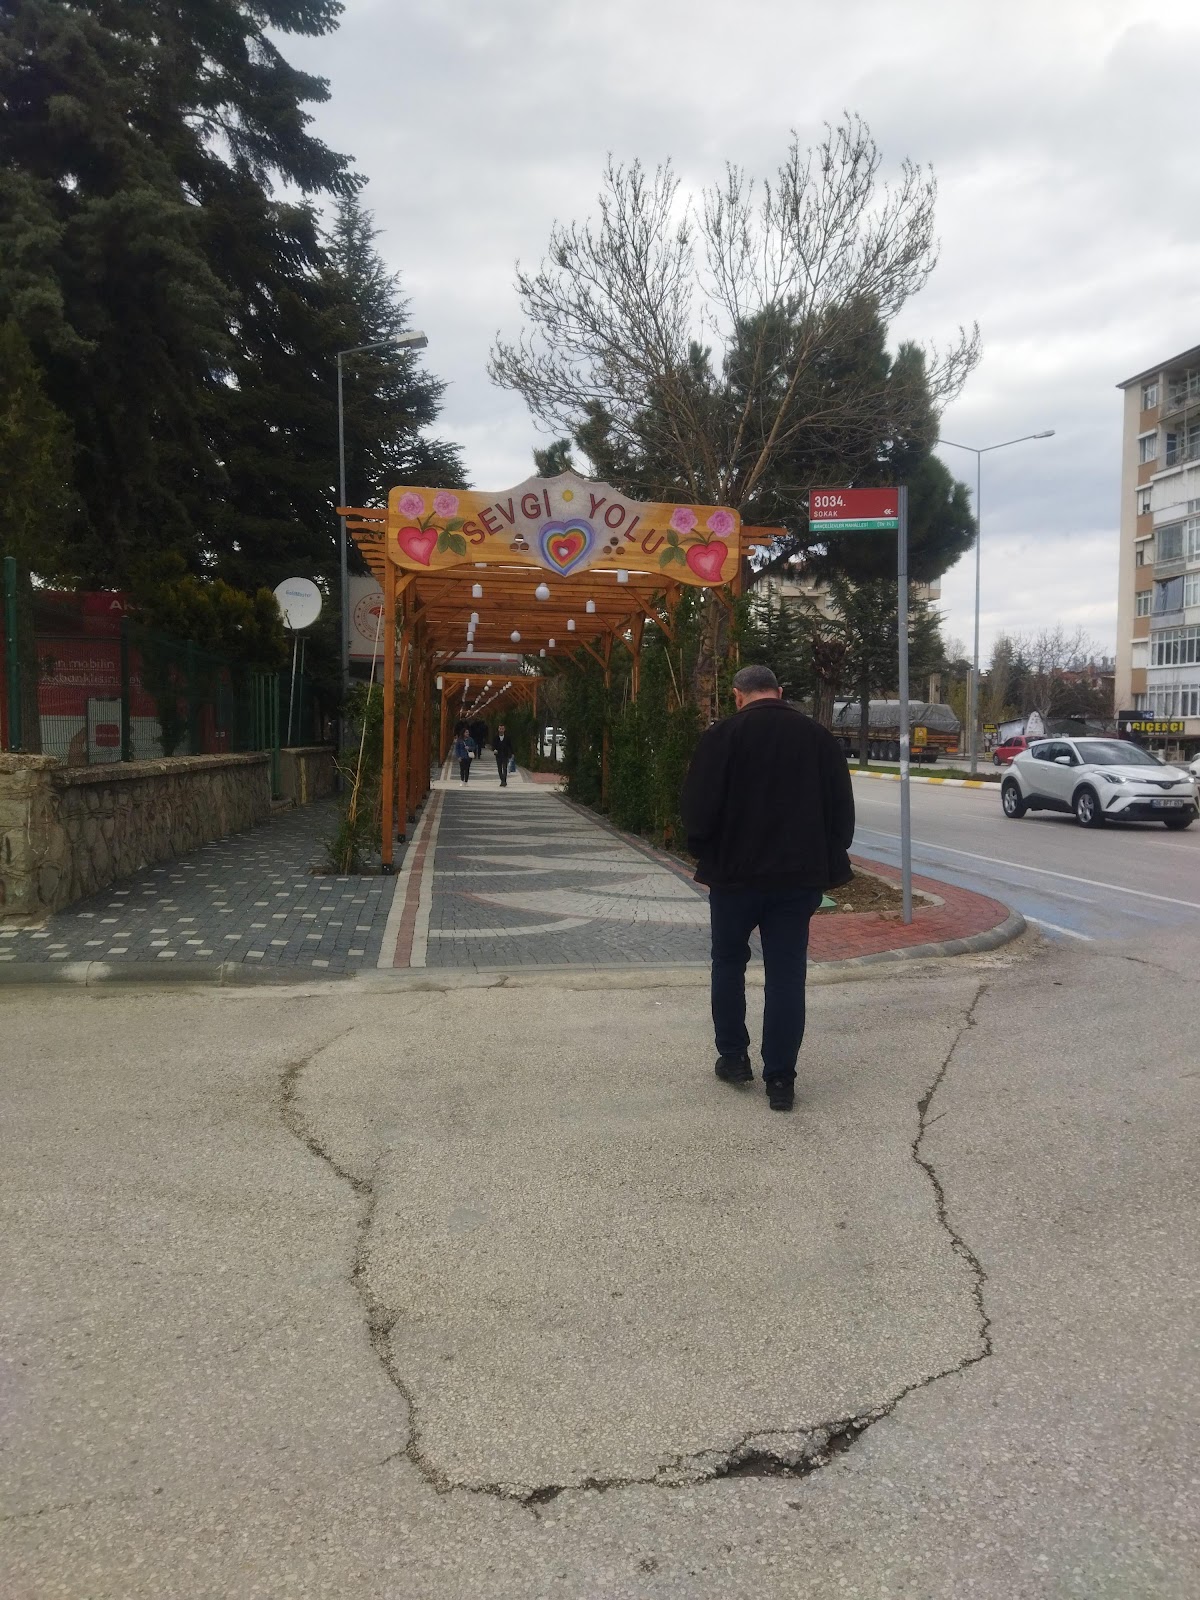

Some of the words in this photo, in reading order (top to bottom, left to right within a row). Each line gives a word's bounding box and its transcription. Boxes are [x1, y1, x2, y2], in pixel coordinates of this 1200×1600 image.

[814, 495, 847, 508] 3034.
[813, 510, 838, 518] SOKAK
[588, 493, 665, 554] YOLU
